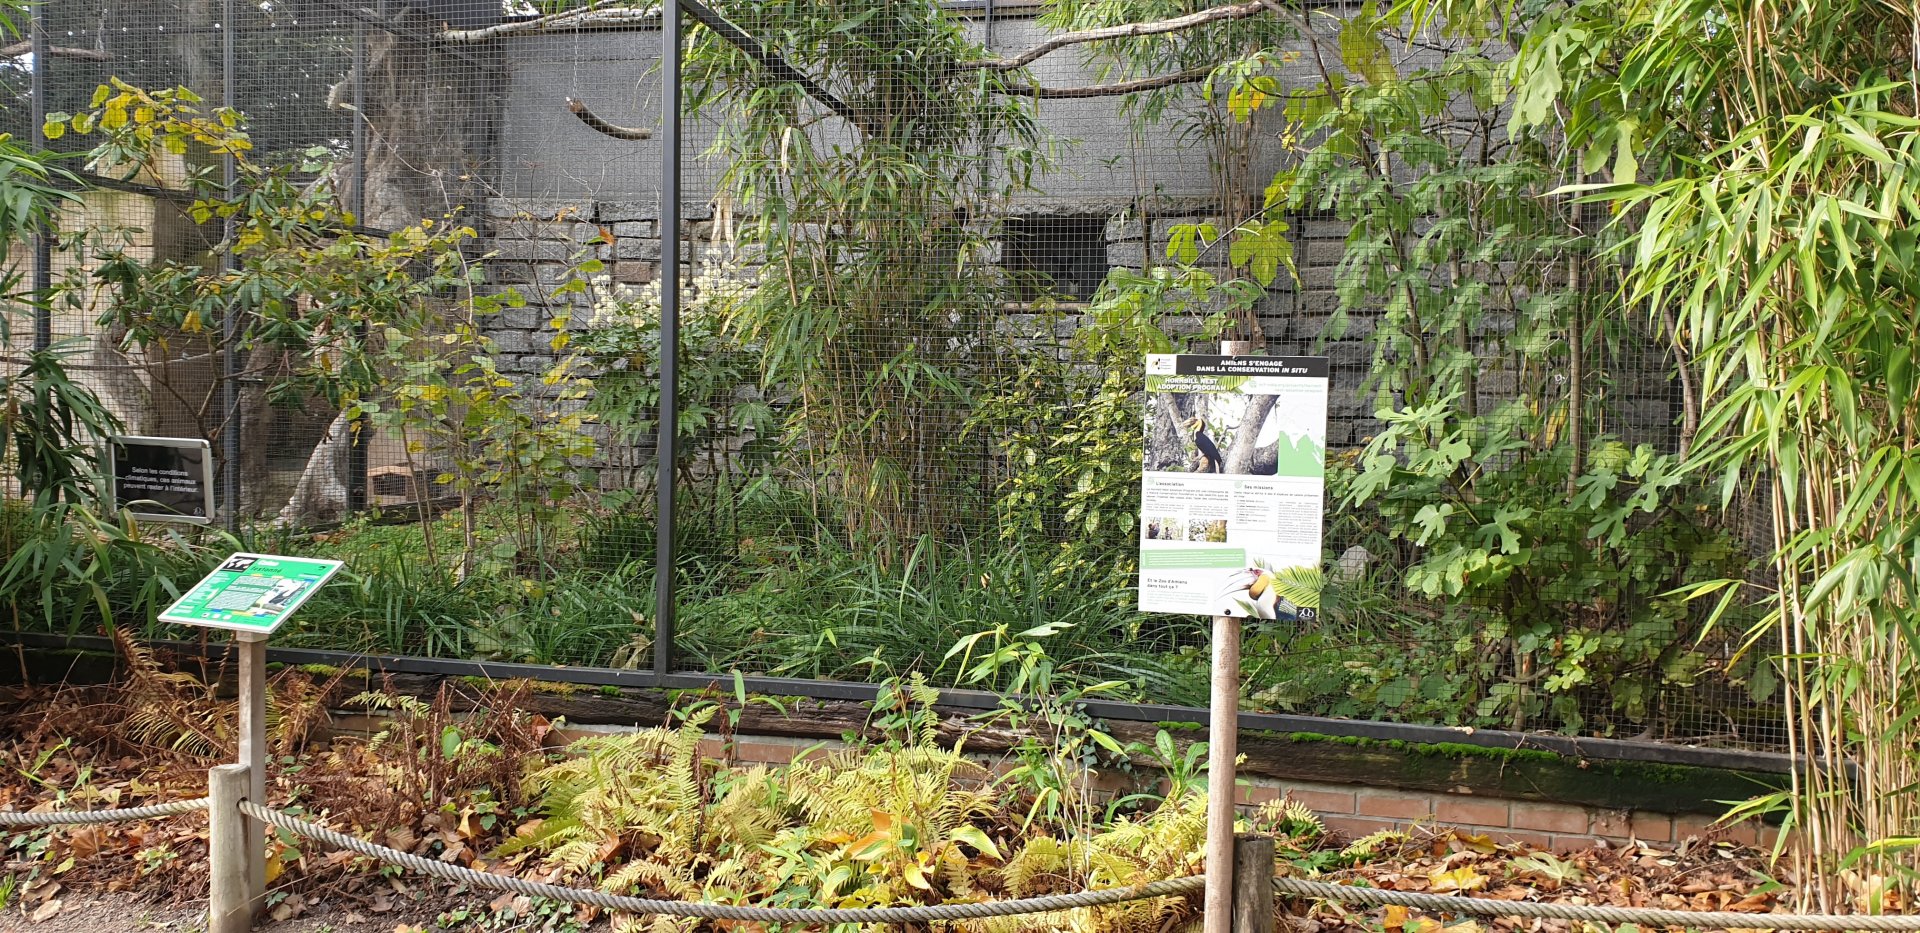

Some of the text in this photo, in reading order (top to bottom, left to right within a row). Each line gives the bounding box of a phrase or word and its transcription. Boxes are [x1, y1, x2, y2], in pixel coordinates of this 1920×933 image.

[131, 466, 148, 474] Selon
[159, 469, 189, 477] conditions
[124, 474, 159, 483] climatiques,
